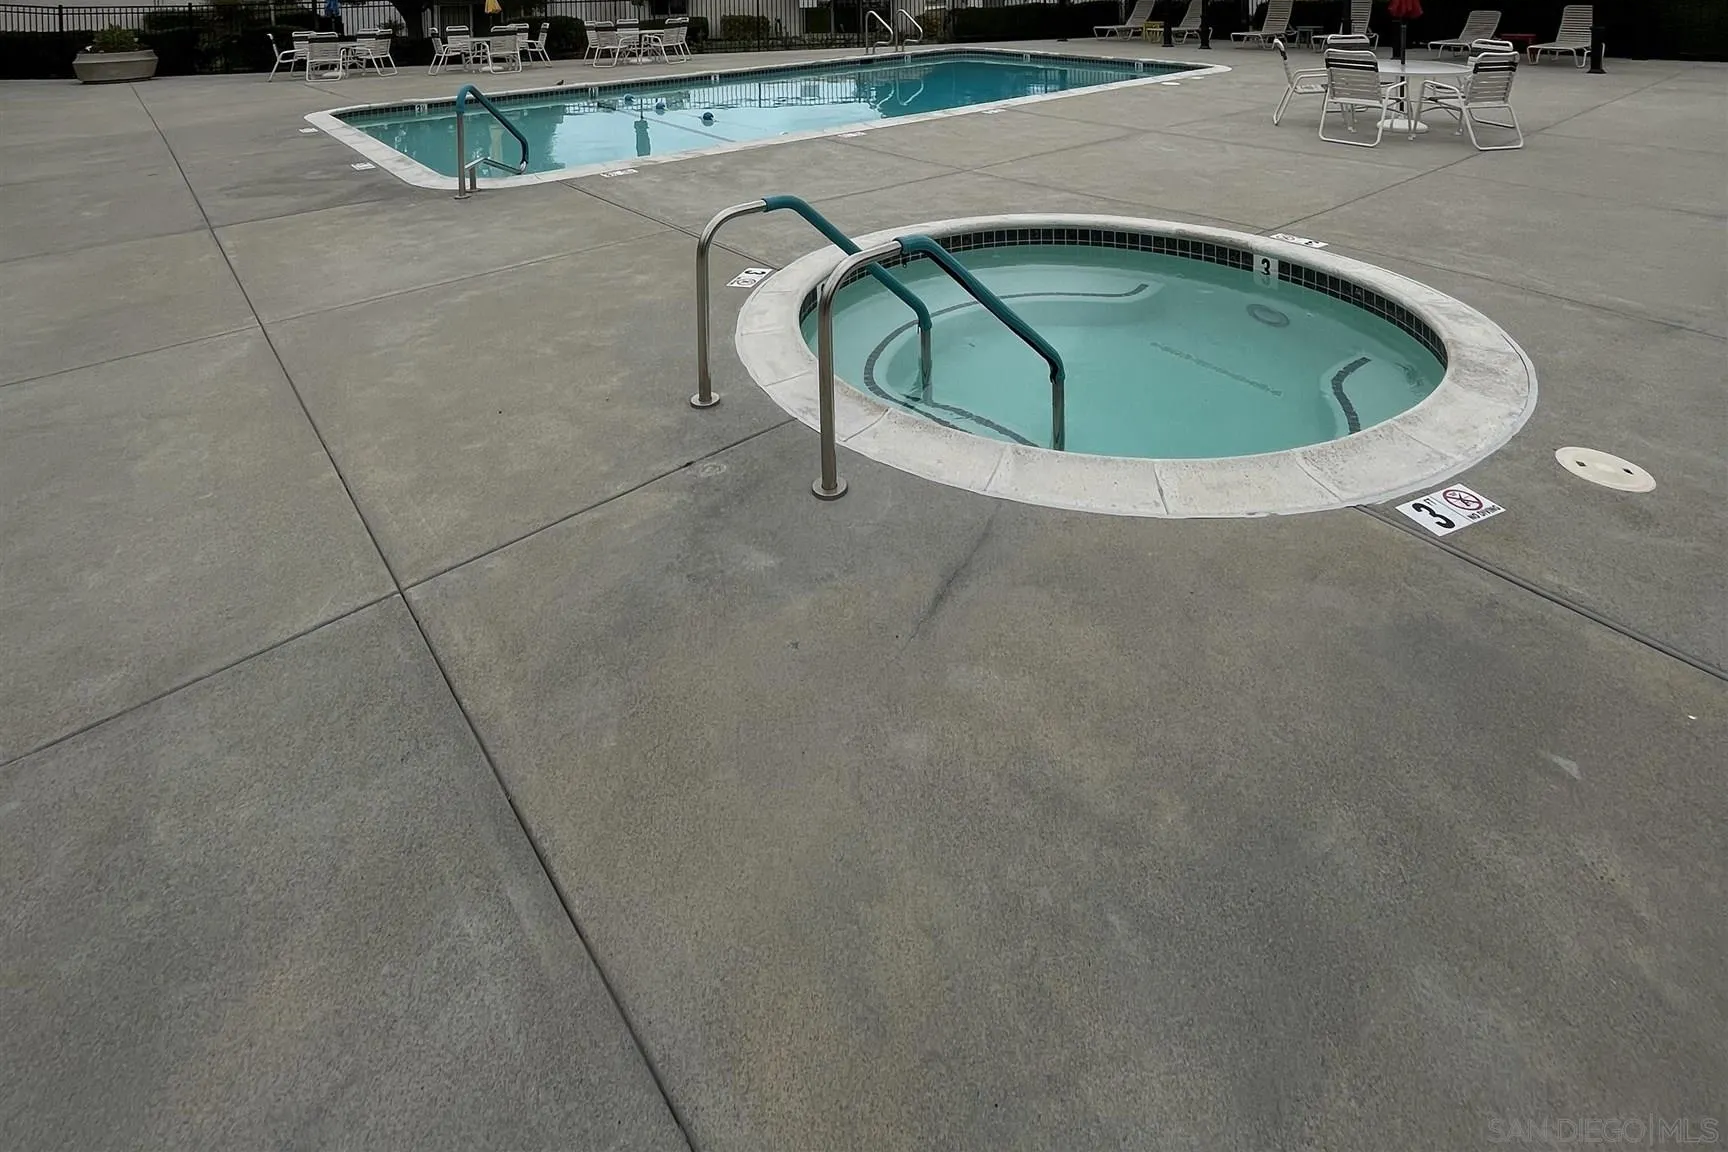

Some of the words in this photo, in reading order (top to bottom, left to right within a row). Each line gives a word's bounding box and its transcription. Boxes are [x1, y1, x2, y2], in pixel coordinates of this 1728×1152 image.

[1261, 258, 1270, 275] 3
[1412, 502, 1455, 529] 3
[1467, 512, 1480, 520] NO
[1479, 504, 1501, 517] DIVING
